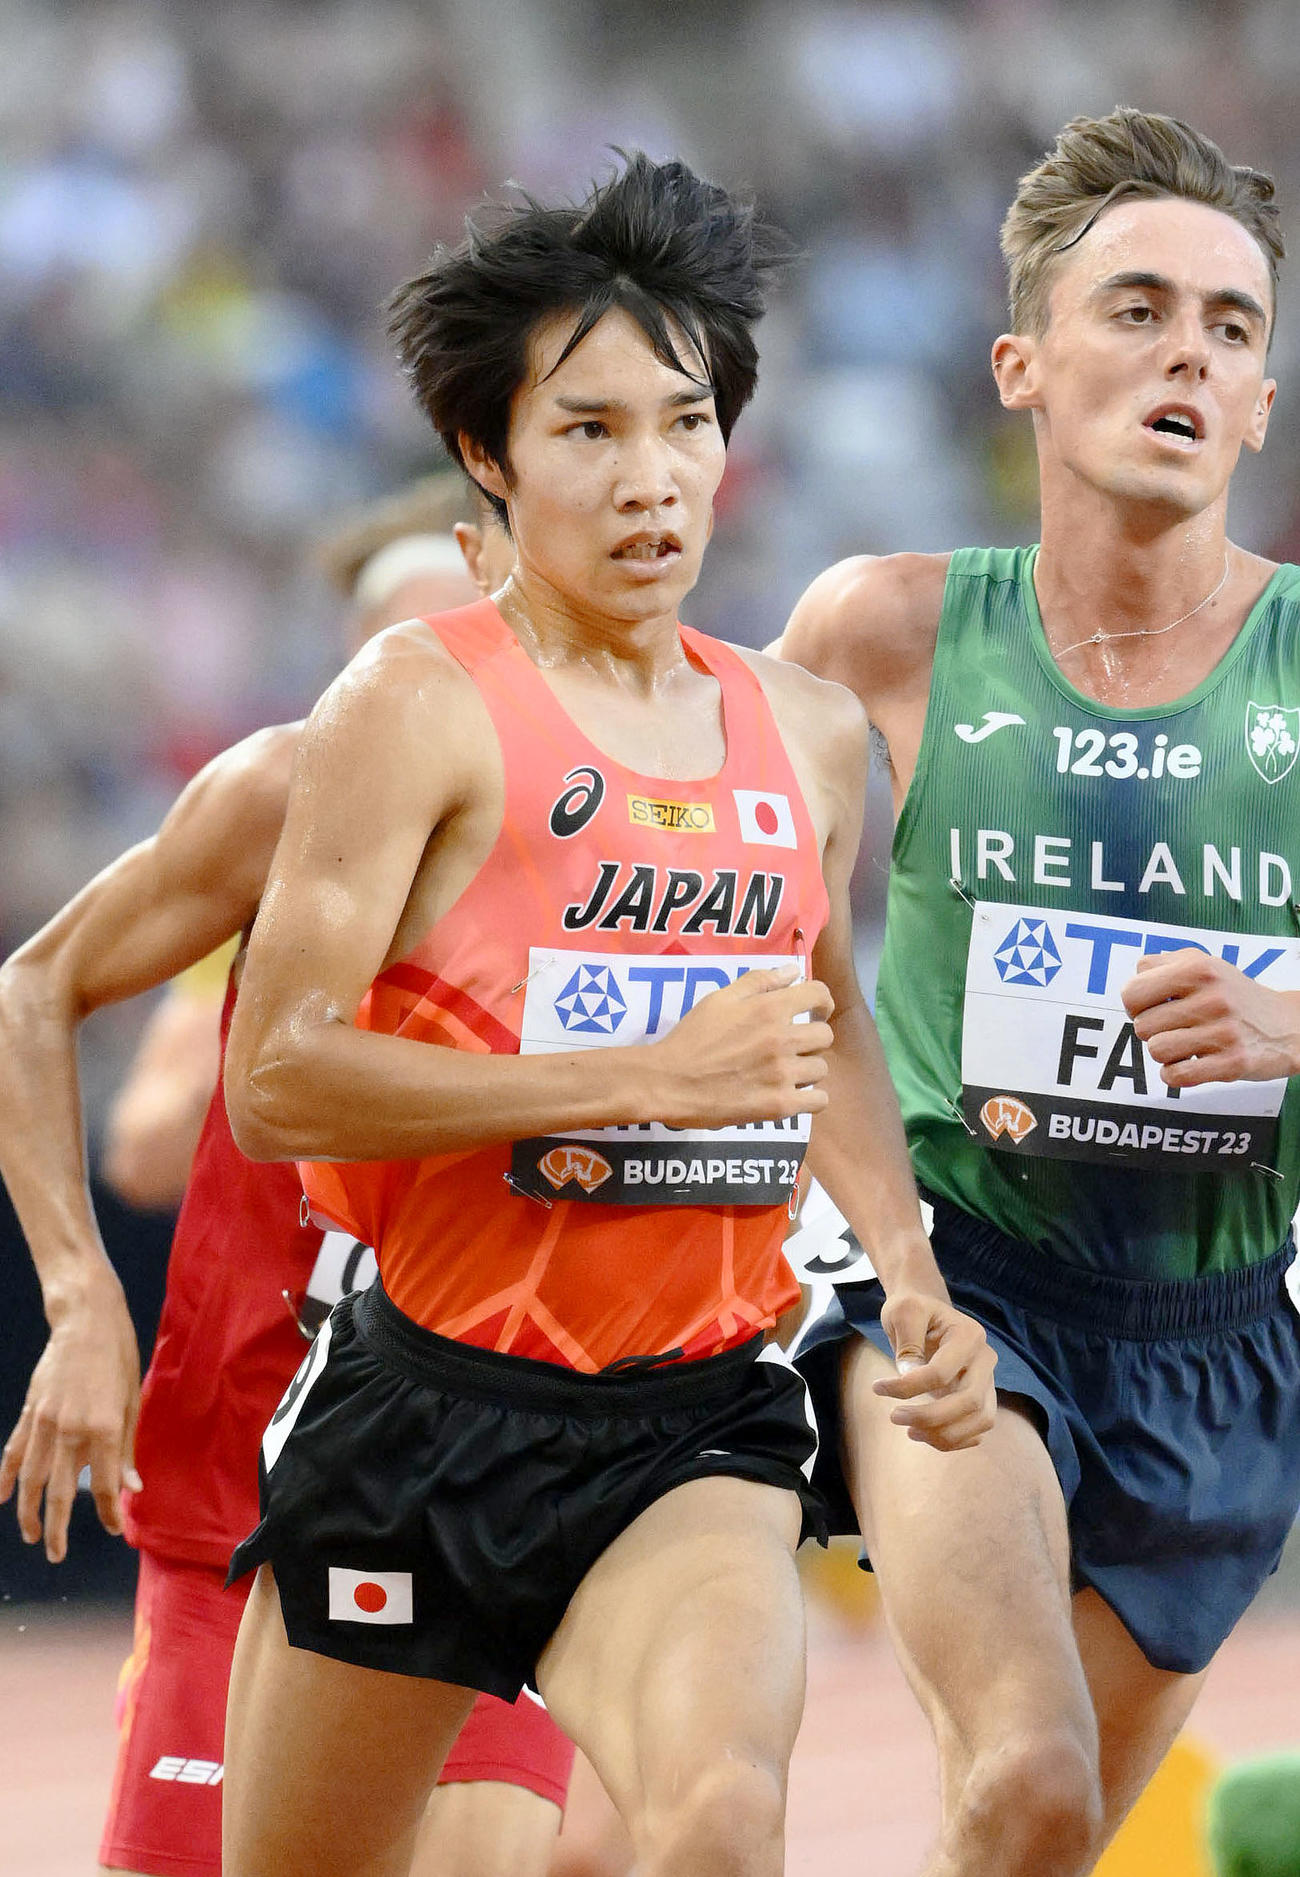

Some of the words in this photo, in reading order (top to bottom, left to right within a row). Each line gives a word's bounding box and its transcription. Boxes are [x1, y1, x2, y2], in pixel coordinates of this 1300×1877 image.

[1053, 727, 1202, 780] 123.ie
[631, 800, 710, 829] SEIKO
[564, 864, 784, 937] JAPAN
[950, 828, 1292, 907] IRELAND
[1056, 1014, 1182, 1099] FA
